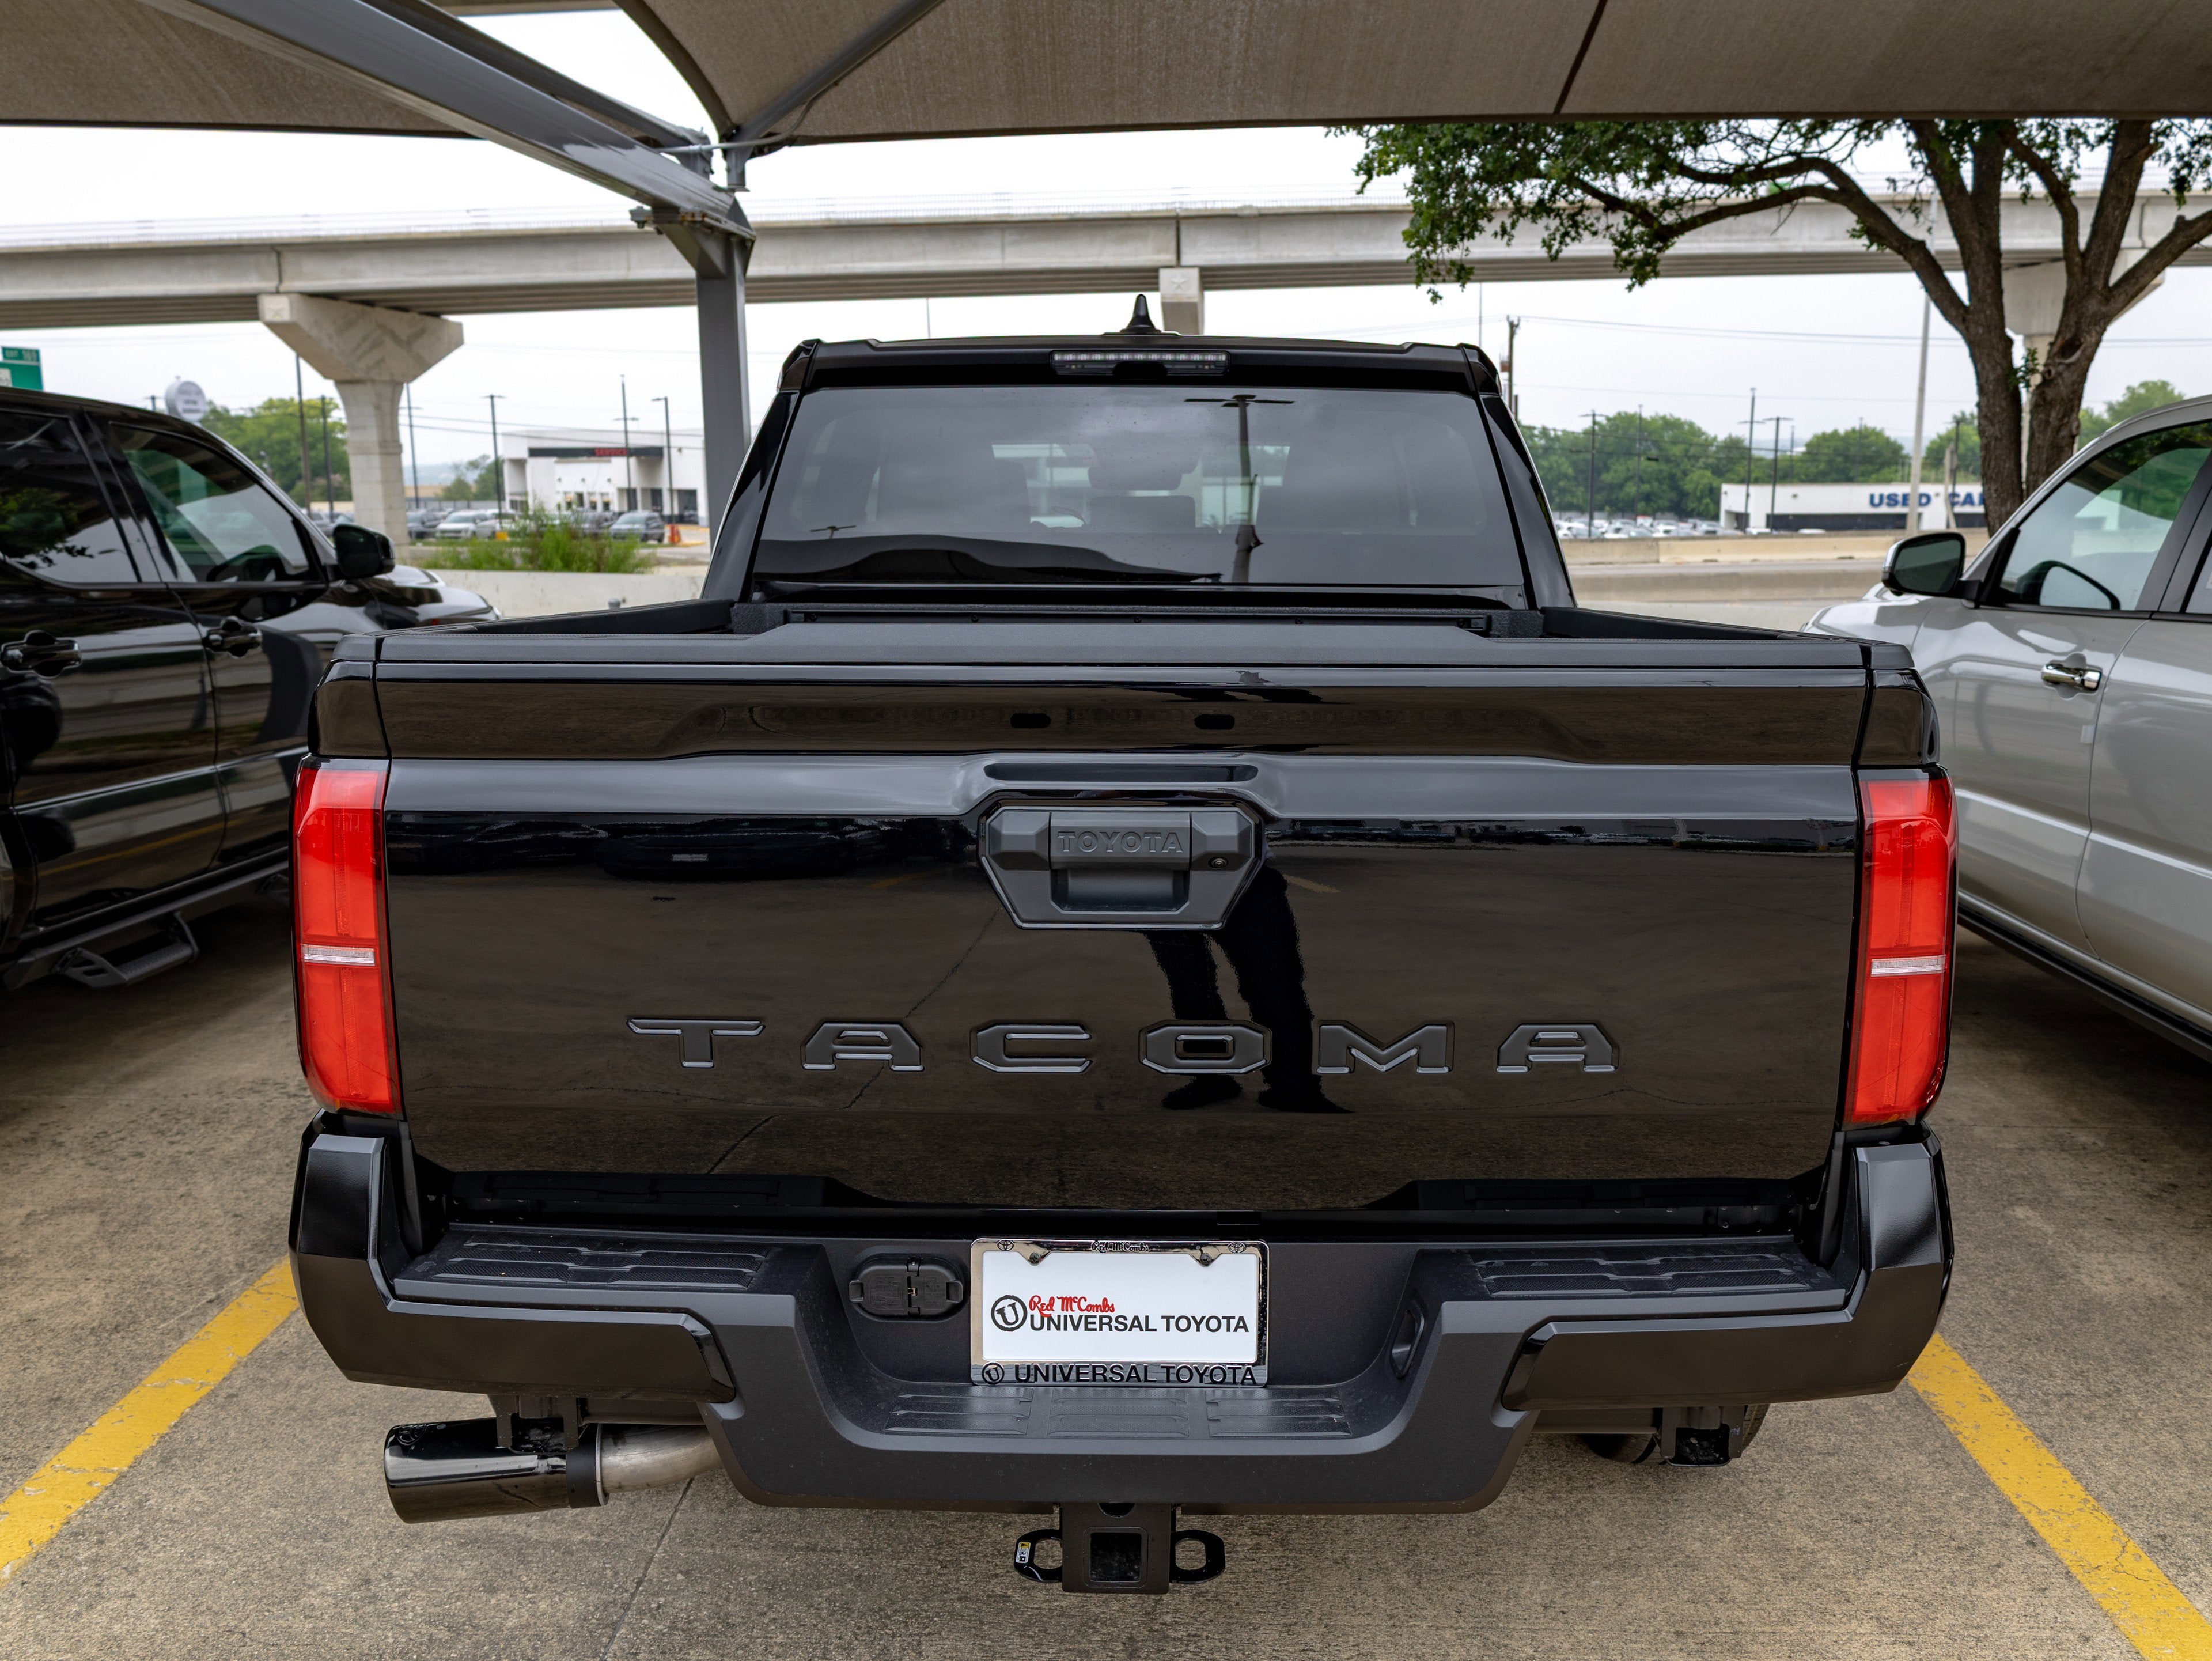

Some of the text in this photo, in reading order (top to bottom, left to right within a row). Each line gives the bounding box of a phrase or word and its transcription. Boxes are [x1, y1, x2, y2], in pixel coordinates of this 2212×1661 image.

[1869, 493, 1932, 507] USED
[1057, 831, 1184, 853] TOYOTA
[627, 1017, 1619, 1075] TACOMA
[1092, 1240, 1150, 1253] Red McCombs
[1029, 1295, 1115, 1318] Red McCombs
[1030, 1314, 1249, 1333] UNIVERSAL TOYOTA
[1014, 1363, 1257, 1386] UNIVERSAL TOYOTA
